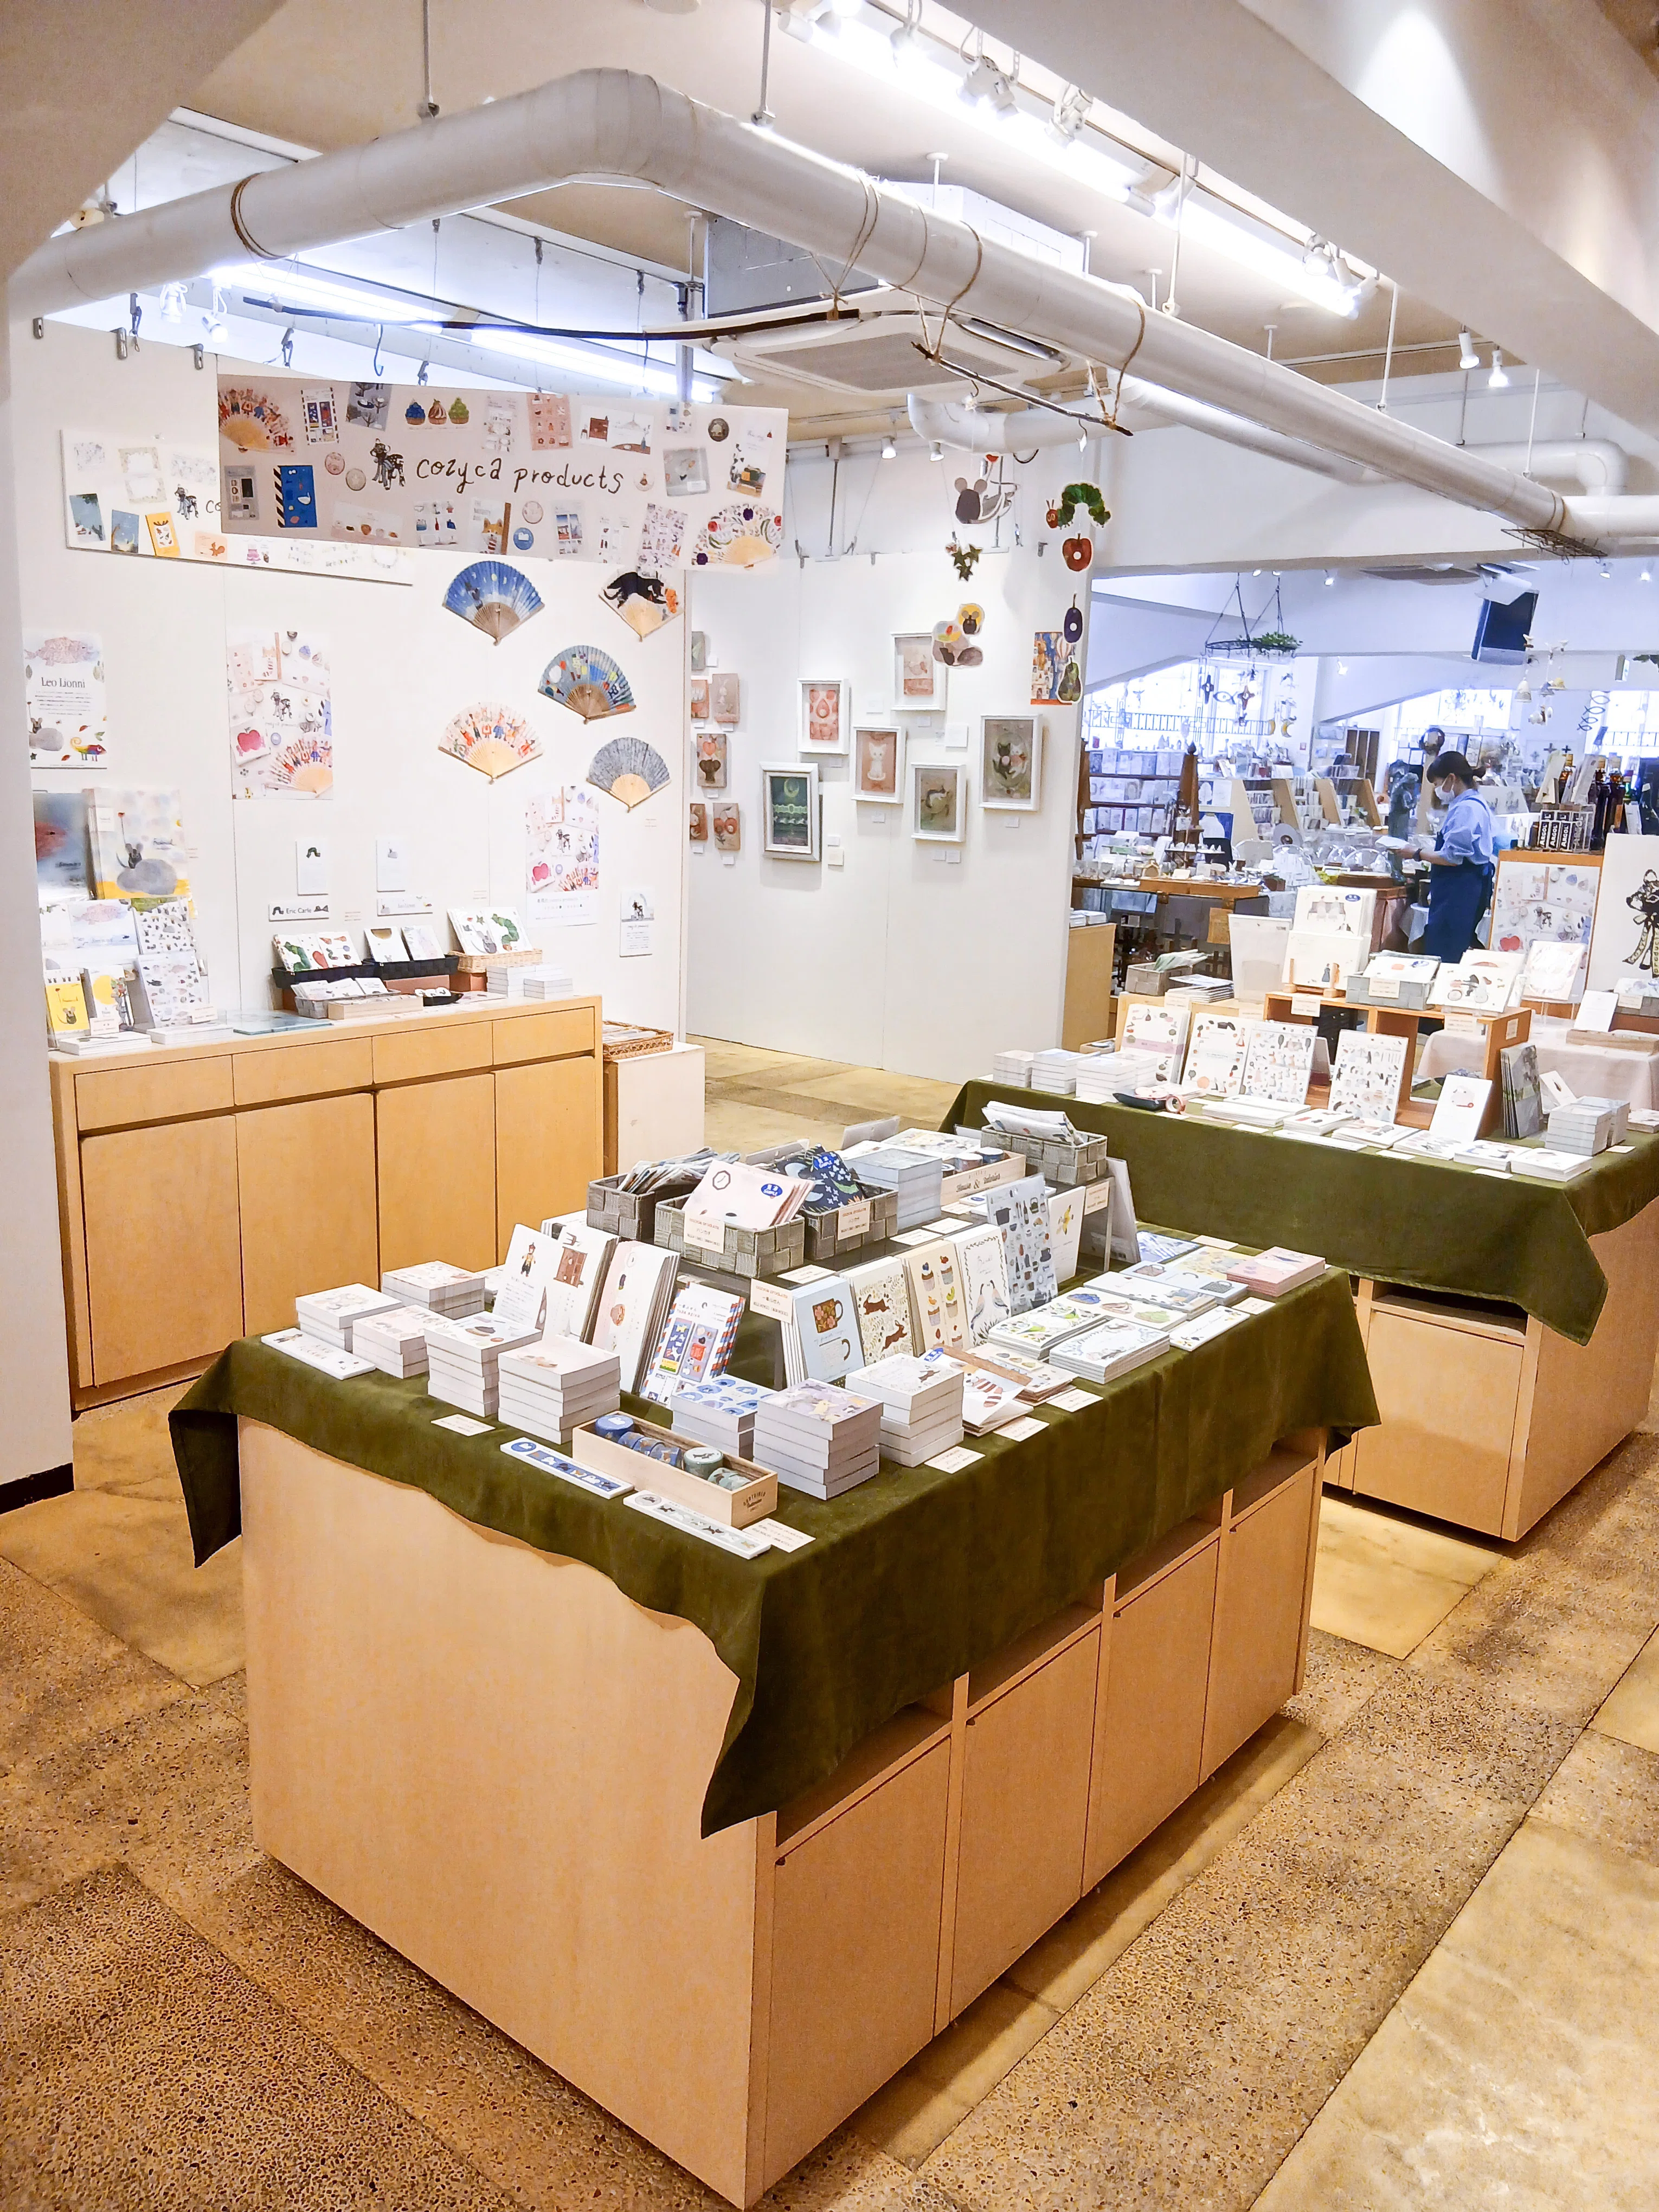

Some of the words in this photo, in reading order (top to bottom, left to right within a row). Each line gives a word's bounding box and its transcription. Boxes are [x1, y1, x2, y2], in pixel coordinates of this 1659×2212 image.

[514, 463, 624, 494] products
[41, 677, 57, 686] Leo
[59, 678, 85, 688] Lionni
[1550, 825, 1558, 846] ARGOL
